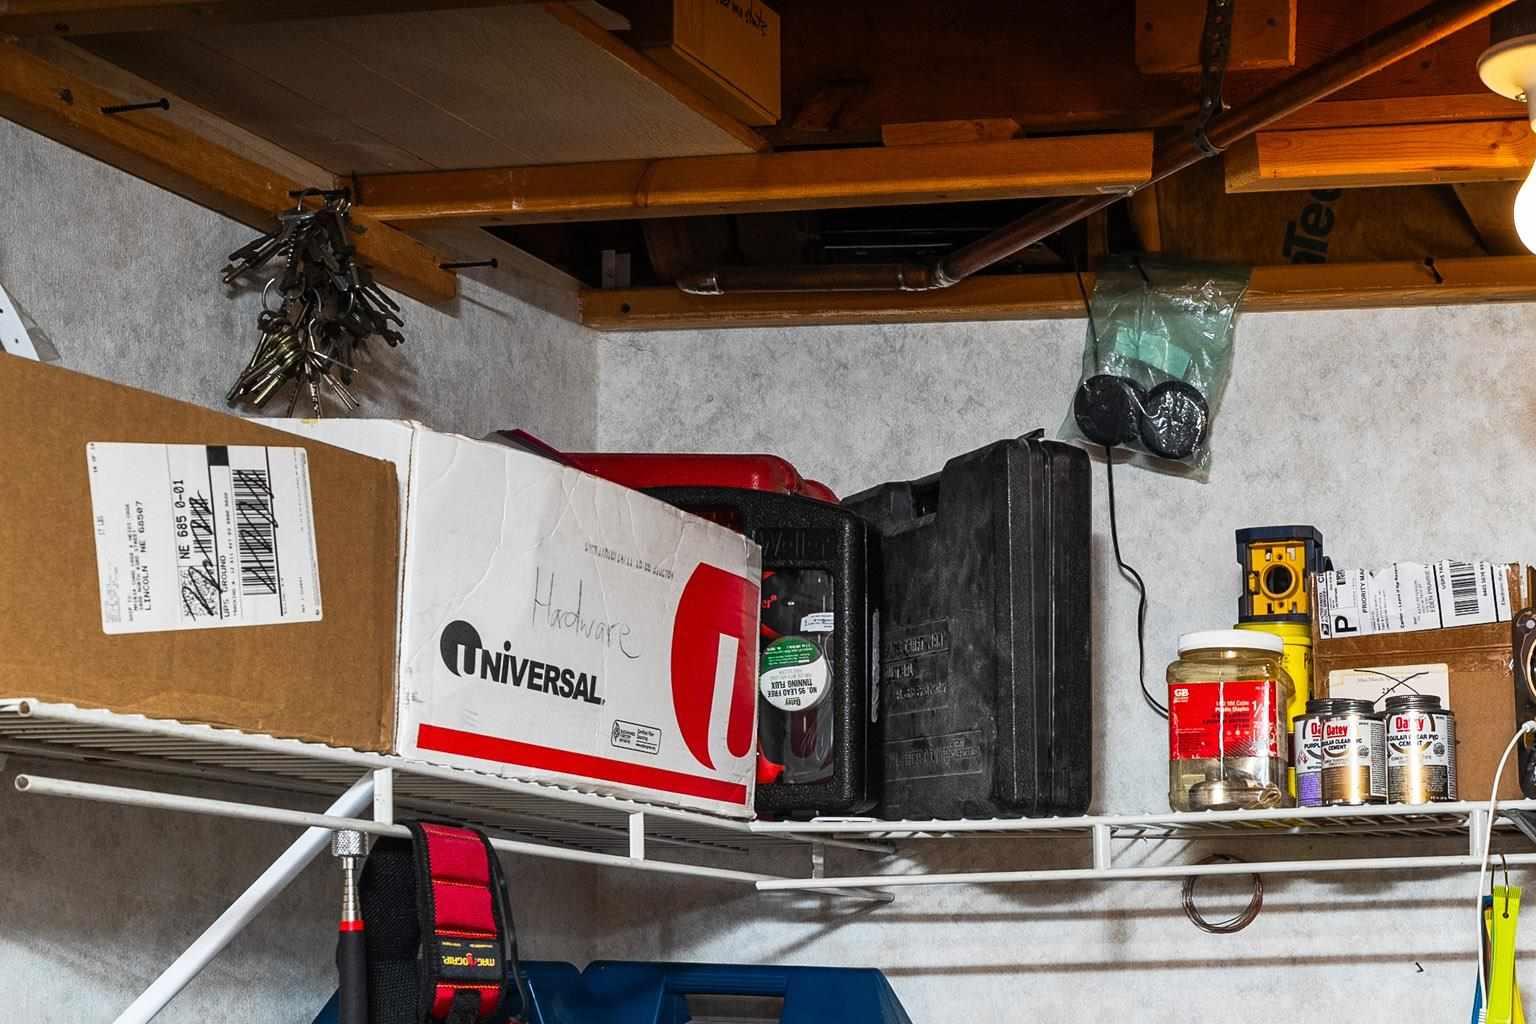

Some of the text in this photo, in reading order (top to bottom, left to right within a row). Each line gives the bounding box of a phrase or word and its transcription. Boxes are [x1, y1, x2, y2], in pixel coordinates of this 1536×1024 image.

[176, 516, 188, 538] 685
[178, 544, 190, 560] NE
[1360, 584, 1369, 614] PRIORITY
[531, 565, 641, 661] Hardware
[771, 679, 812, 690] FLUX TINNING
[767, 690, 782, 698] FREE
[783, 688, 798, 697] LEAD
[1174, 688, 1189, 697] GB
[1326, 724, 1349, 737] Oatey
[1395, 716, 1425, 731] Oay
